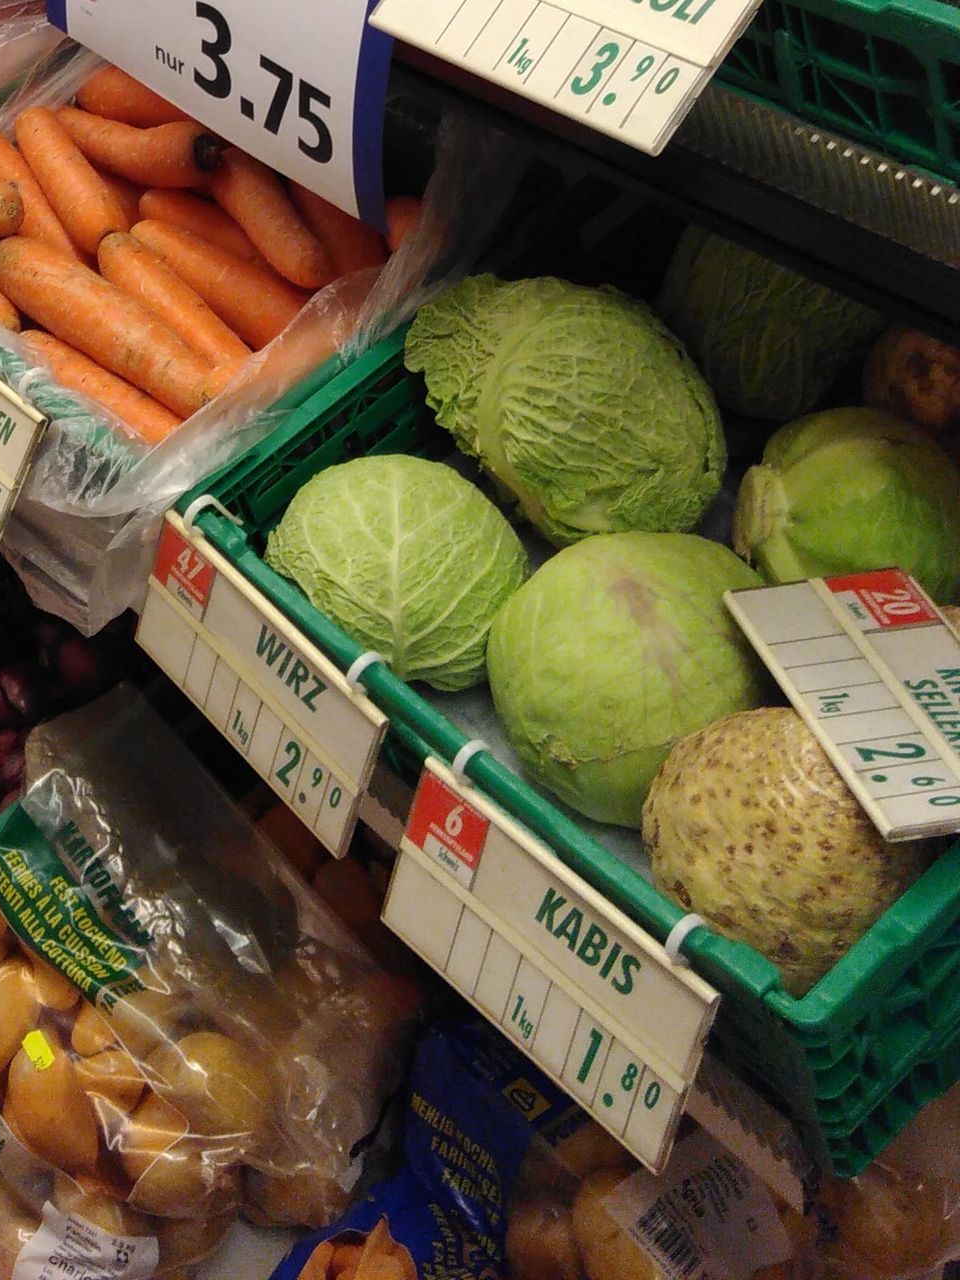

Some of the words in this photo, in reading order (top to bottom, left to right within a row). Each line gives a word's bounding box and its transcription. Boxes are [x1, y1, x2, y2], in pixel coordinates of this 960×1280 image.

[154, 43, 187, 76] nur
[193, 0, 334, 165] 3.75
[506, 37, 534, 76] 1kg
[870, 588, 922, 617] 20
[254, 623, 329, 714] WIRZ
[230, 708, 251, 747] 1kg
[817, 691, 851, 715] 1kg
[443, 804, 465, 838] 6
[4, 847, 44, 902] FERMES
[44, 904, 64, 929] LA
[57, 923, 111, 980] CUISSON
[49, 875, 80, 908] FEST
[70, 905, 129, 972] KOCHEND
[533, 886, 642, 997] KABIS
[18, 908, 46, 944] ALLA
[41, 940, 94, 992] COTTURA
[509, 993, 534, 1041] 1kg
